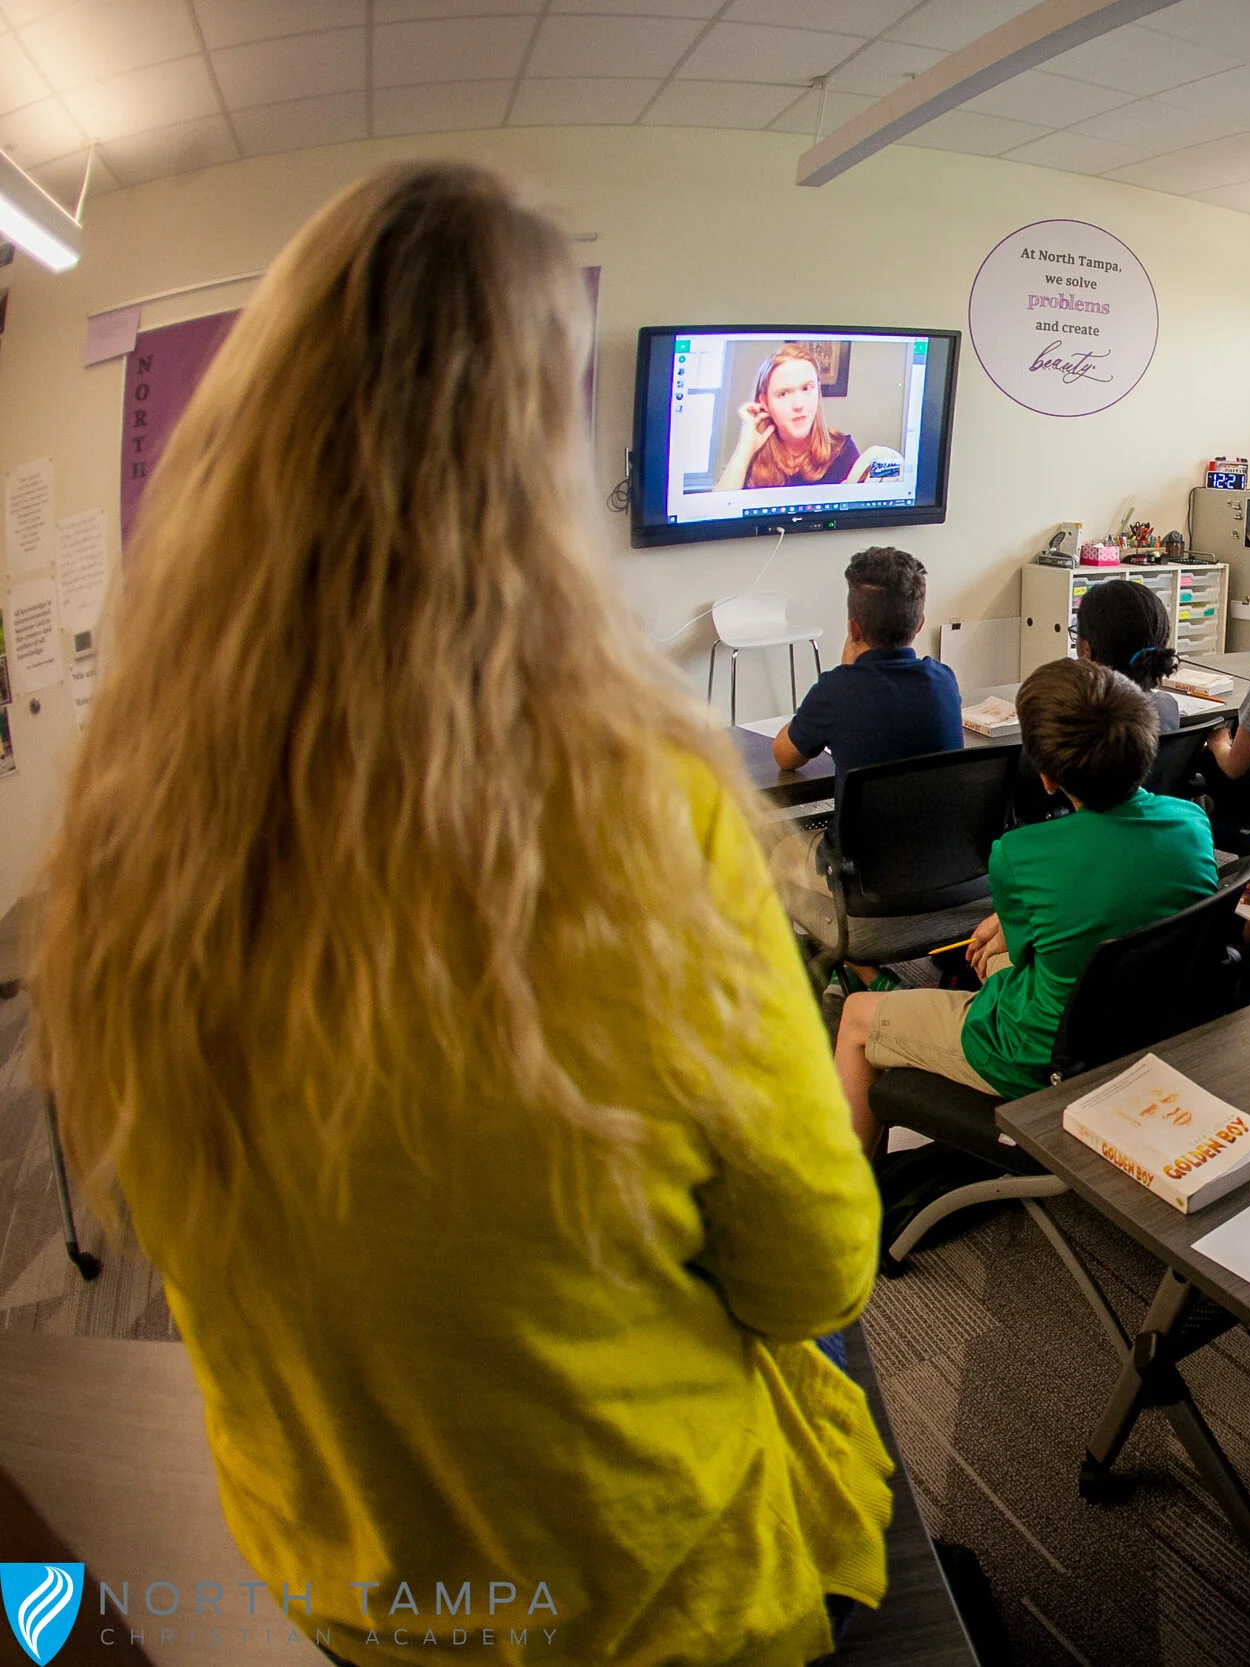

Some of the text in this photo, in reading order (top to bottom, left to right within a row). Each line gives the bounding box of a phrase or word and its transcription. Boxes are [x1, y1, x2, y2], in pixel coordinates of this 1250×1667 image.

[1021, 248, 1123, 273] At North Tampa,
[1045, 274, 1098, 290] we solve
[1026, 293, 1110, 315] problems
[1035, 321, 1100, 336] and create
[131, 355, 153, 480] NORTH
[1212, 473, 1245, 489] 12:21
[1162, 1136, 1227, 1180] GOLDEN
[1216, 1116, 1249, 1144] BOY
[1101, 1142, 1154, 1187] GOLDEN BOY
